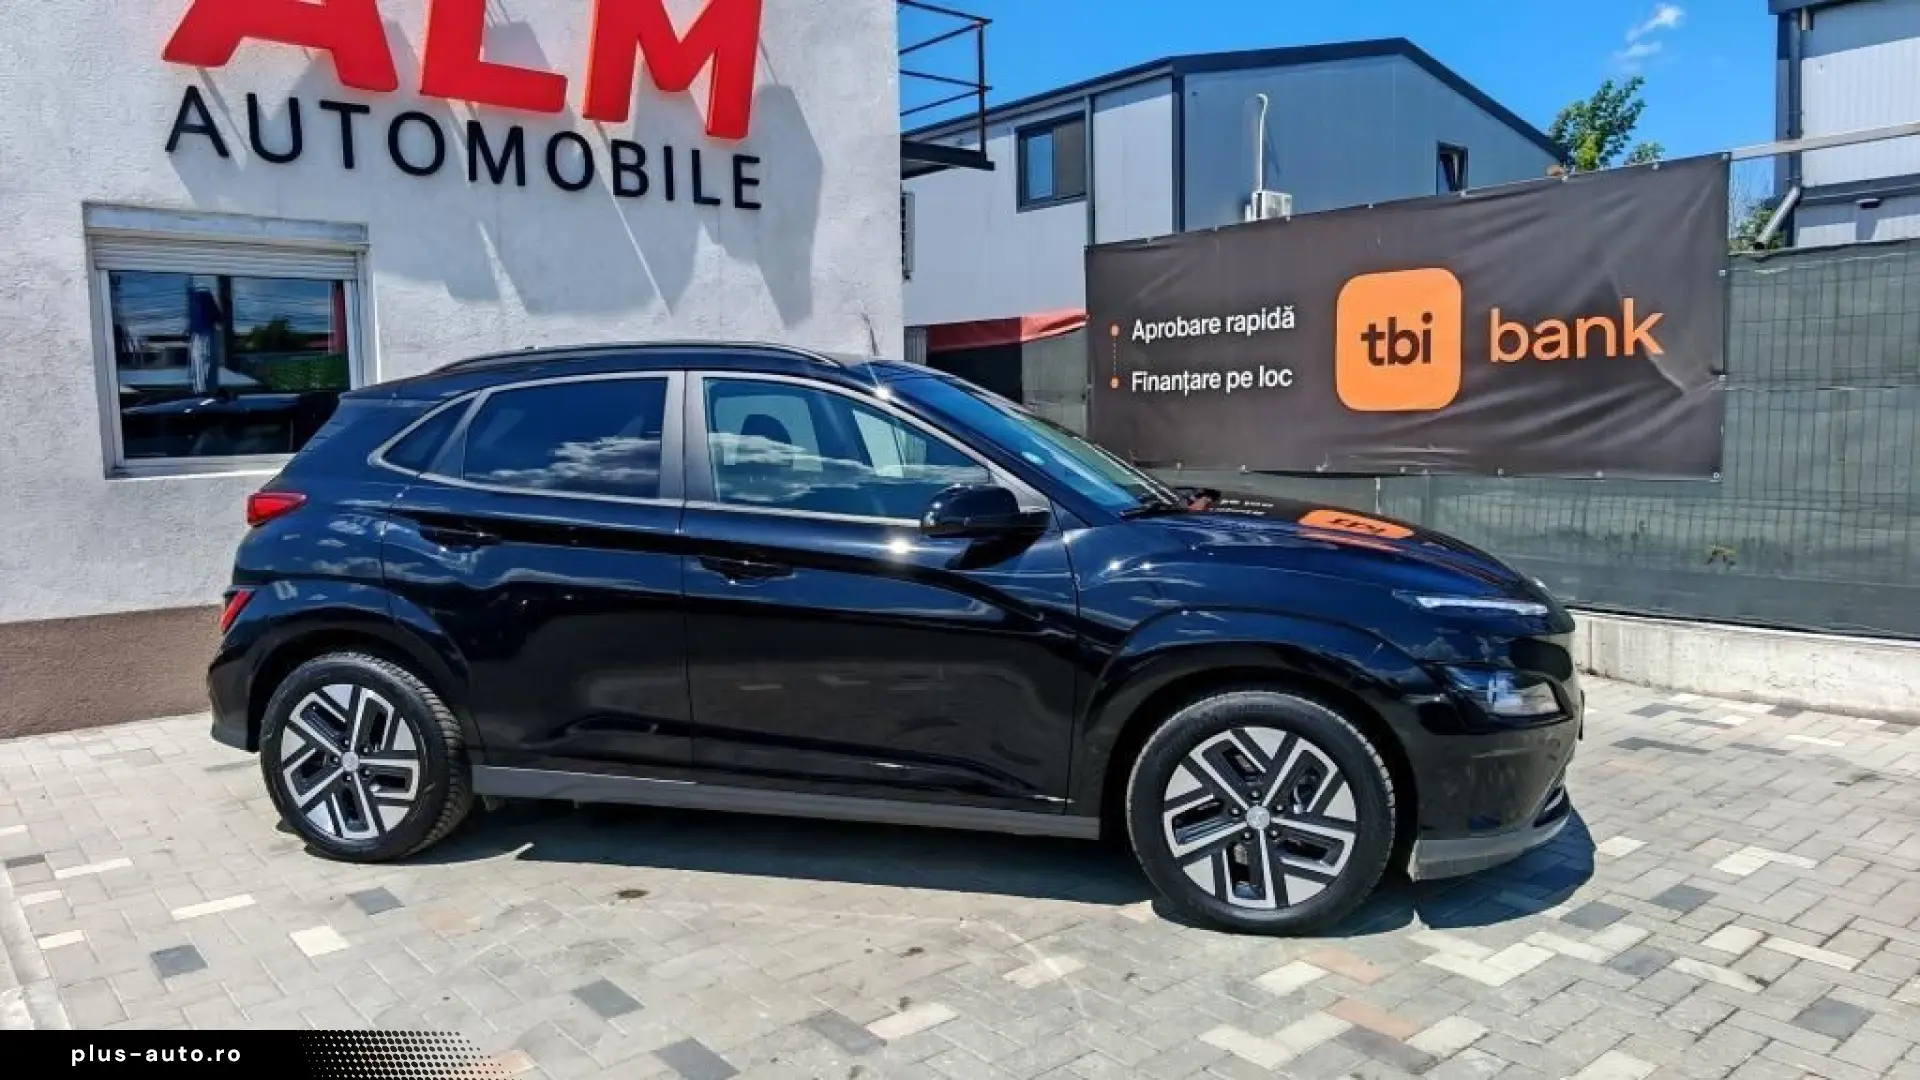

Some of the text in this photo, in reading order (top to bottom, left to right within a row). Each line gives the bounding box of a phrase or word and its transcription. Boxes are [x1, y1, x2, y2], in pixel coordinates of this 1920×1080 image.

[165, 85, 761, 210] AUTOMOBILE
[1132, 304, 1295, 344] Aprobare rapidă
[1361, 296, 1665, 367] tbi bank
[1131, 365, 1294, 397] Finanțare pe loc
